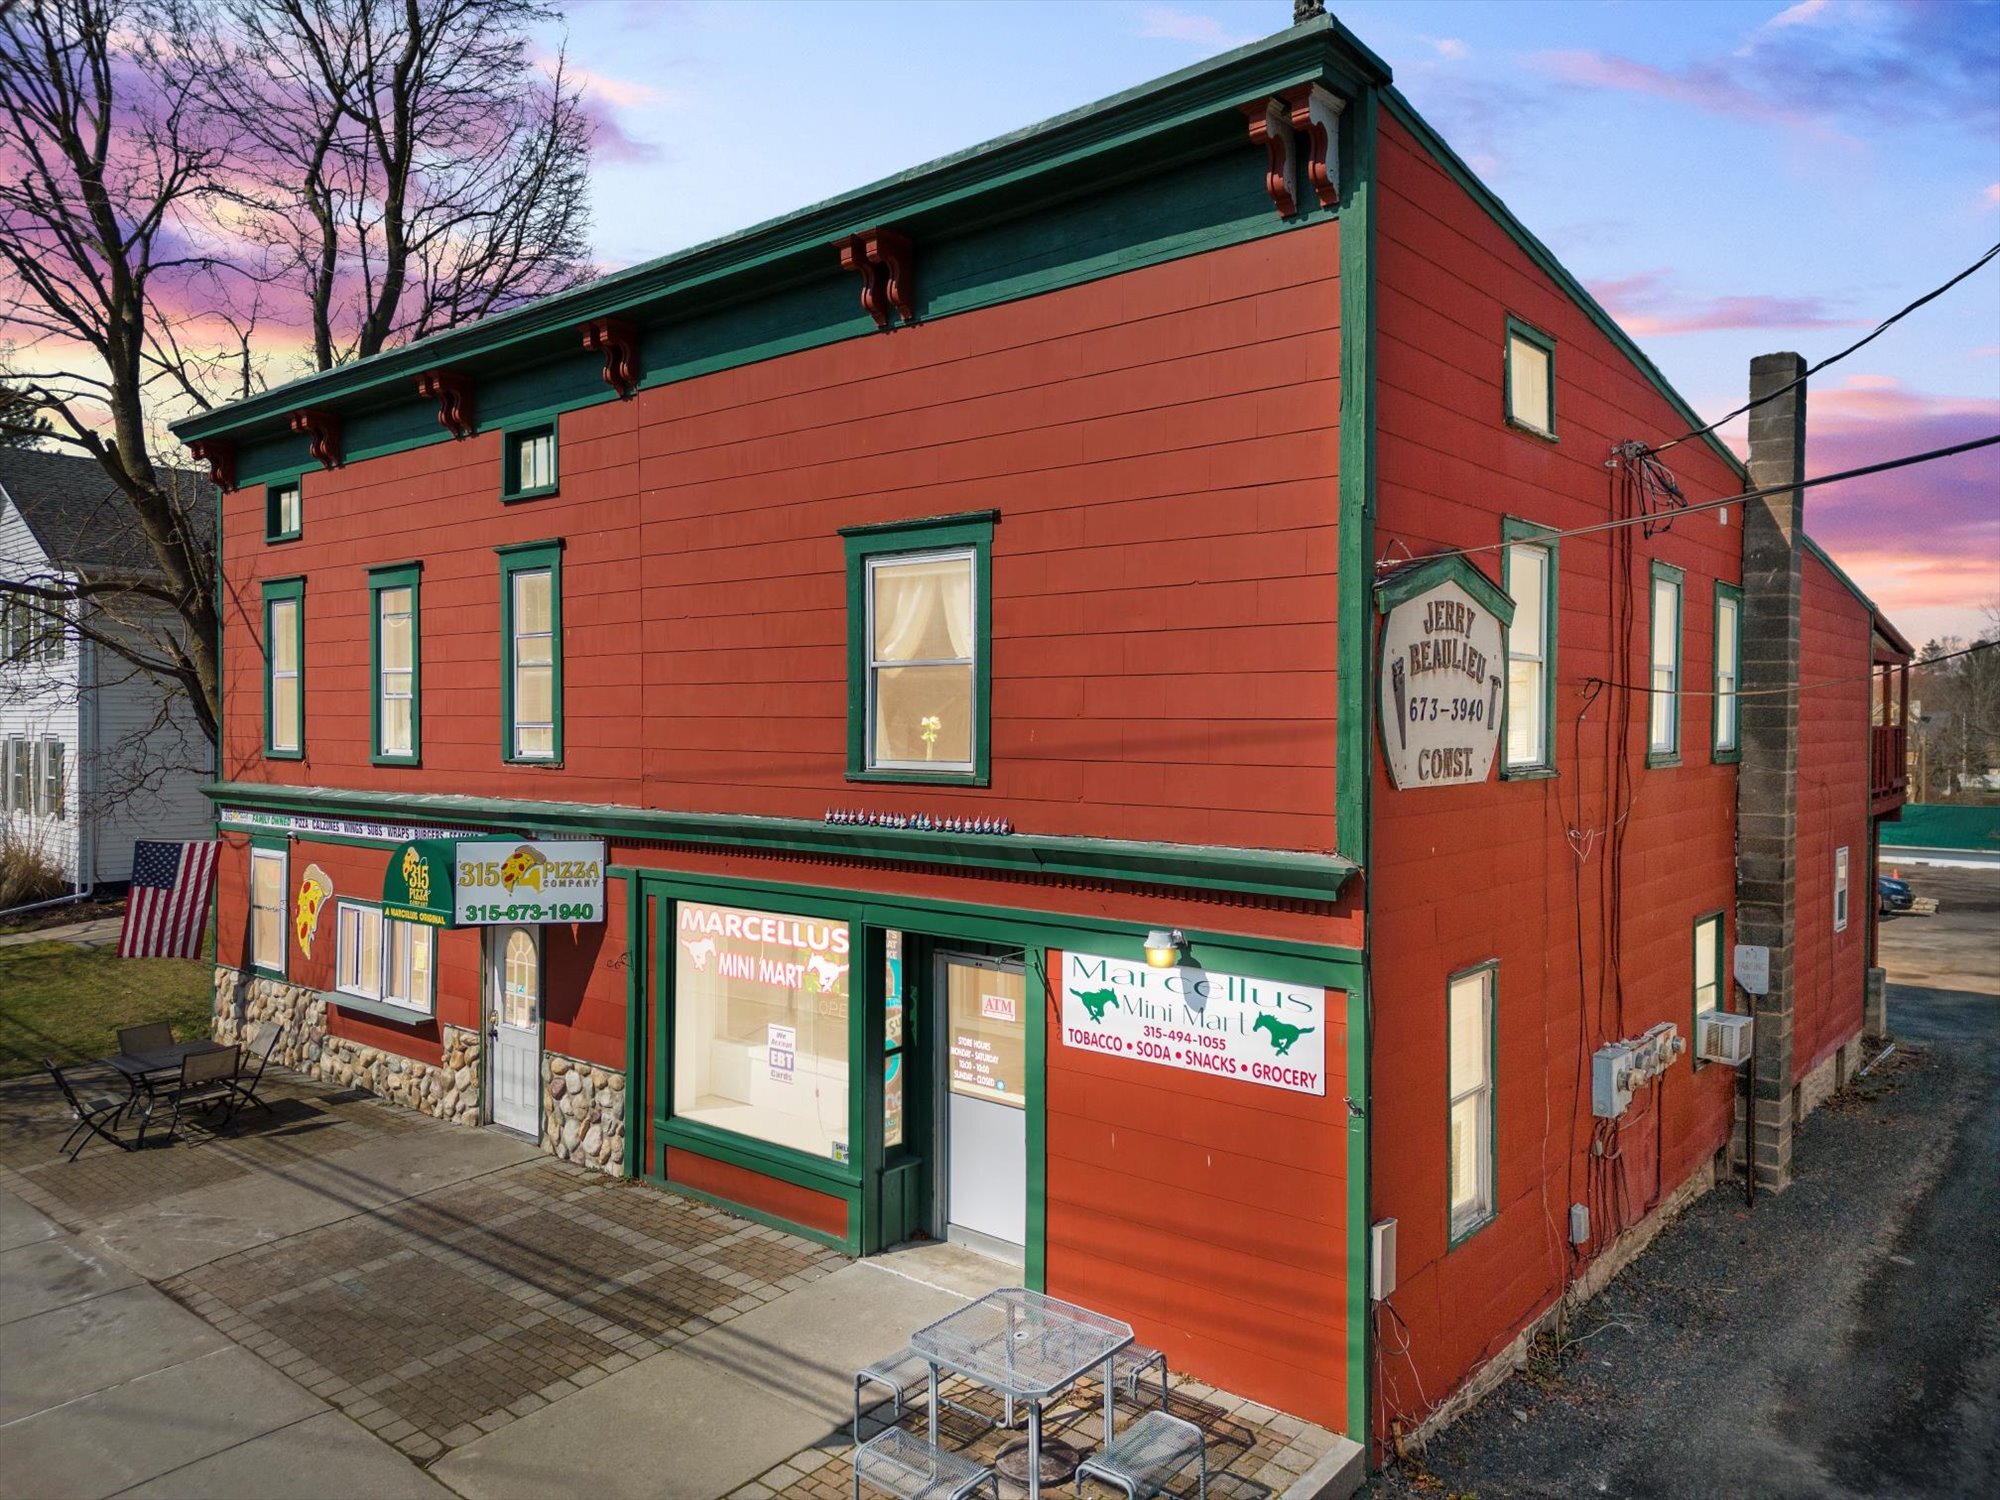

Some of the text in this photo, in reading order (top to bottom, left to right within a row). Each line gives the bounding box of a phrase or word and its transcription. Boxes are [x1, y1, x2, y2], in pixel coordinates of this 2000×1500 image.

[1423, 600, 1476, 639] JERRY
[1408, 638, 1487, 685] BEAULIEU
[1409, 696, 1483, 722] 673-3940
[252, 812, 271, 825] FAMILY
[271, 815, 291, 827] OWNED
[294, 817, 309, 829] PIZZA
[312, 818, 340, 833] CALZONES
[343, 821, 363, 835] WINGS
[367, 824, 383, 837] SUBS
[388, 826, 410, 839] WRAPS
[409, 863, 429, 889] 315
[458, 860, 600, 887] 315 PIZZA
[543, 879, 599, 888] COMPANY
[409, 887, 429, 901] PIZZA
[384, 907, 390, 916] A
[419, 912, 446, 925] ORIGINAL
[464, 903, 594, 922] 315-673-1940
[680, 907, 849, 954] MARCELLUS
[718, 952, 806, 990] MINI MART
[1073, 955, 1313, 1014] Marcellus
[985, 997, 1012, 1013] ATM
[1122, 994, 1249, 1036] Mini Mart
[776, 1031, 787, 1040] We
[958, 1036, 991, 1052] STORE HOURS
[1143, 1025, 1226, 1051] 315-494-1055
[770, 1049, 793, 1070] EBT
[950, 1046, 971, 1059] MONDAY
[974, 1051, 999, 1065] SATURDAY
[1068, 1028, 1318, 1089] TOBACCO SODA SNACKS GROCERY
[770, 1069, 793, 1081] Cards
[953, 1069, 974, 1082] SUNDAY
[976, 1075, 995, 1087] CLOSED
